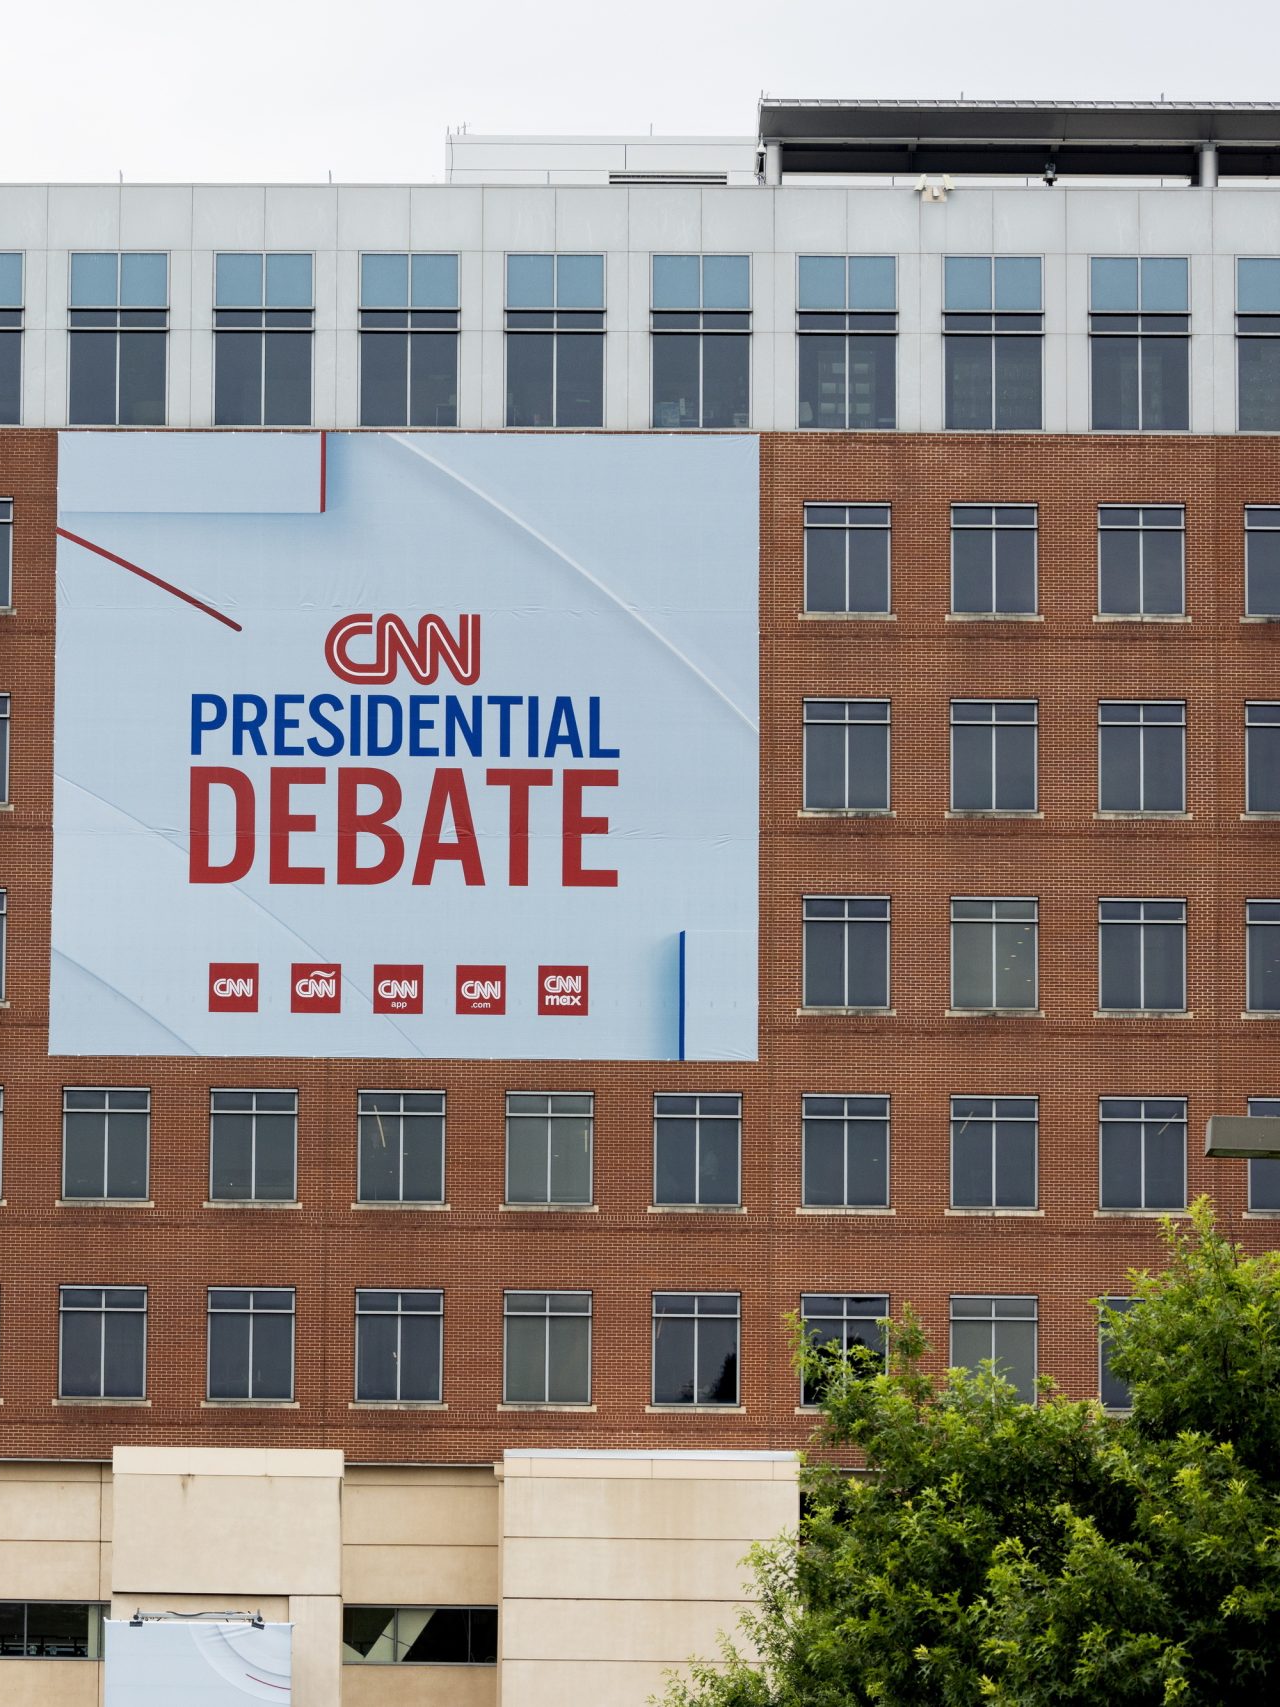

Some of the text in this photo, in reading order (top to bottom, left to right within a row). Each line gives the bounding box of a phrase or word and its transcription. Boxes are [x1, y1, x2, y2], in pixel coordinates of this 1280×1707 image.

[325, 614, 480, 686] CNN
[191, 694, 620, 758] PRESIDENTIAL
[190, 767, 618, 886] DEBATE
[213, 978, 254, 997] CNN
[377, 979, 418, 999] CNN
[460, 980, 501, 1000] CNN
[543, 974, 582, 994] CNN
[390, 1001, 407, 1010] app
[470, 1001, 491, 1009] .com
[544, 994, 582, 1007] max
